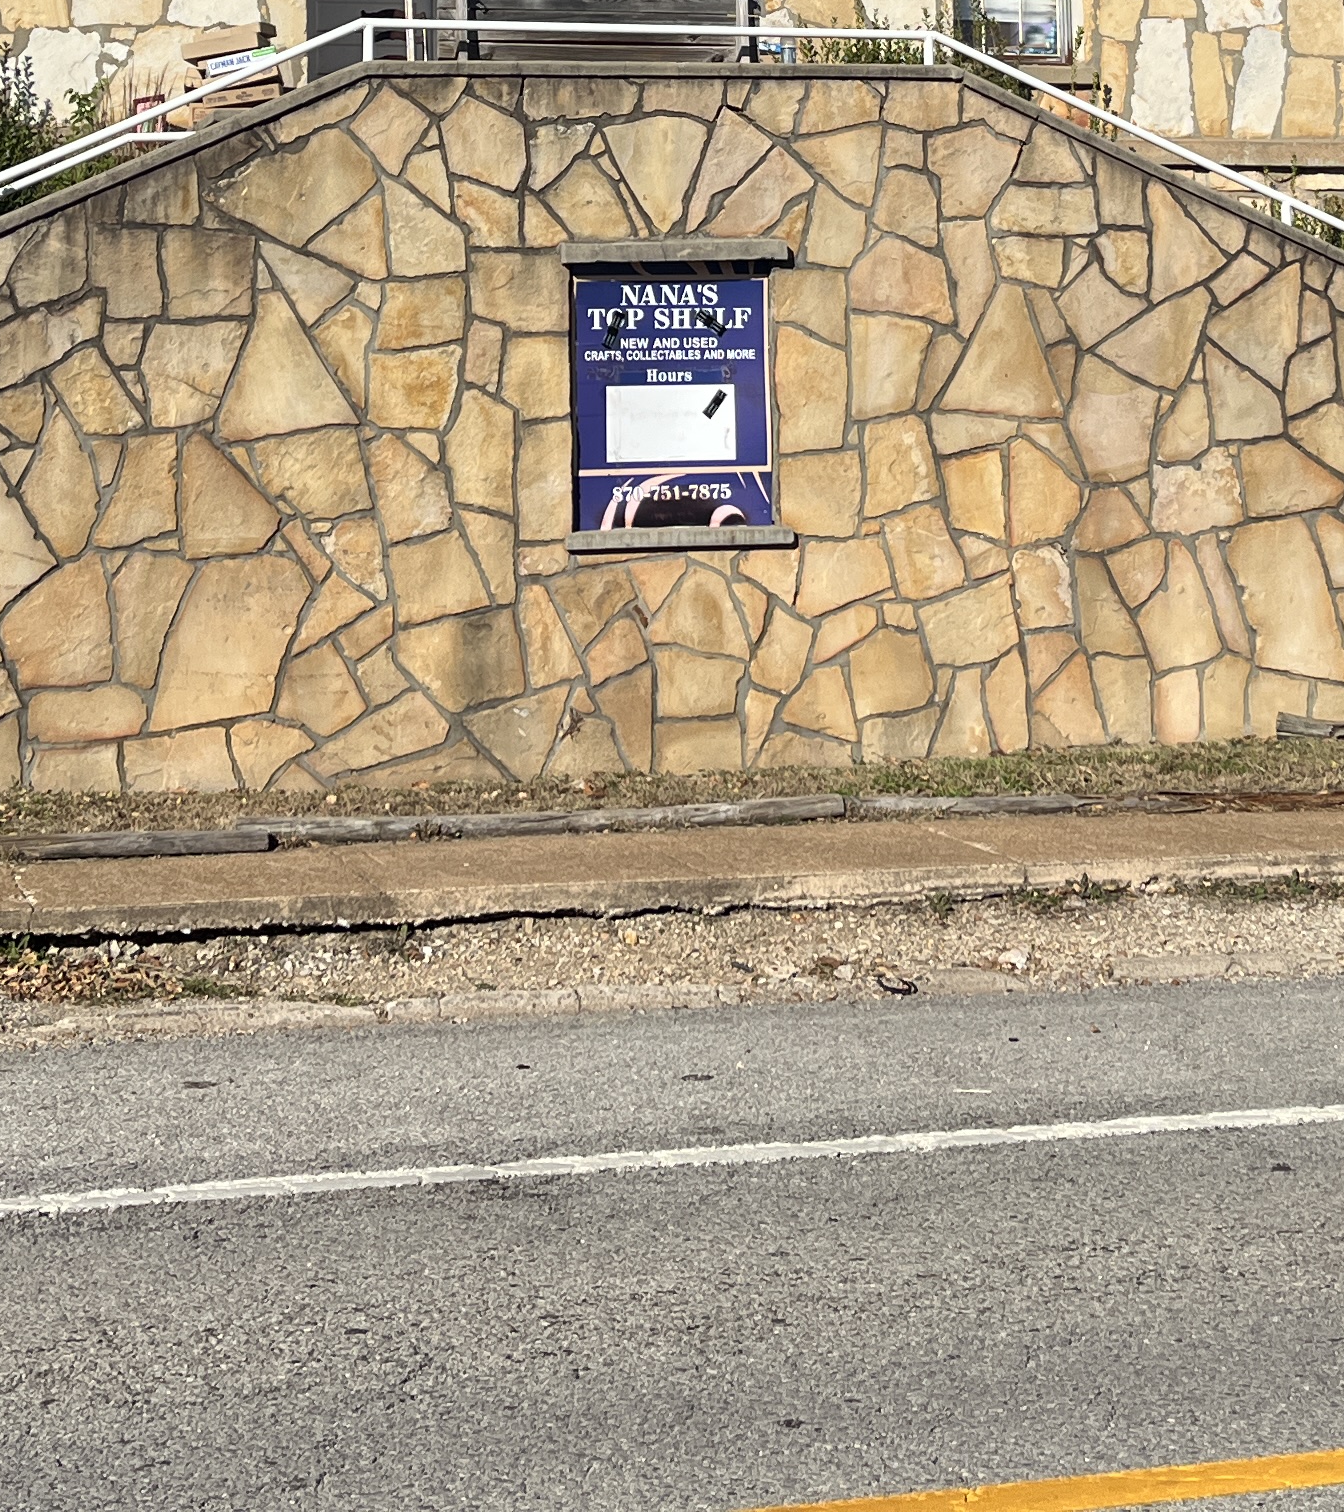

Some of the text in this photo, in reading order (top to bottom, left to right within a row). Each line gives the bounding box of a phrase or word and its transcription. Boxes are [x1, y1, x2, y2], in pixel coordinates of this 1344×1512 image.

[619, 284, 719, 306] NANA'S
[620, 337, 719, 349] NEW AND USED
[584, 349, 756, 363] CRAFTS, COLLECTABLES AND MORE
[646, 368, 693, 383] Hours
[612, 483, 732, 503] 870-751-7875
